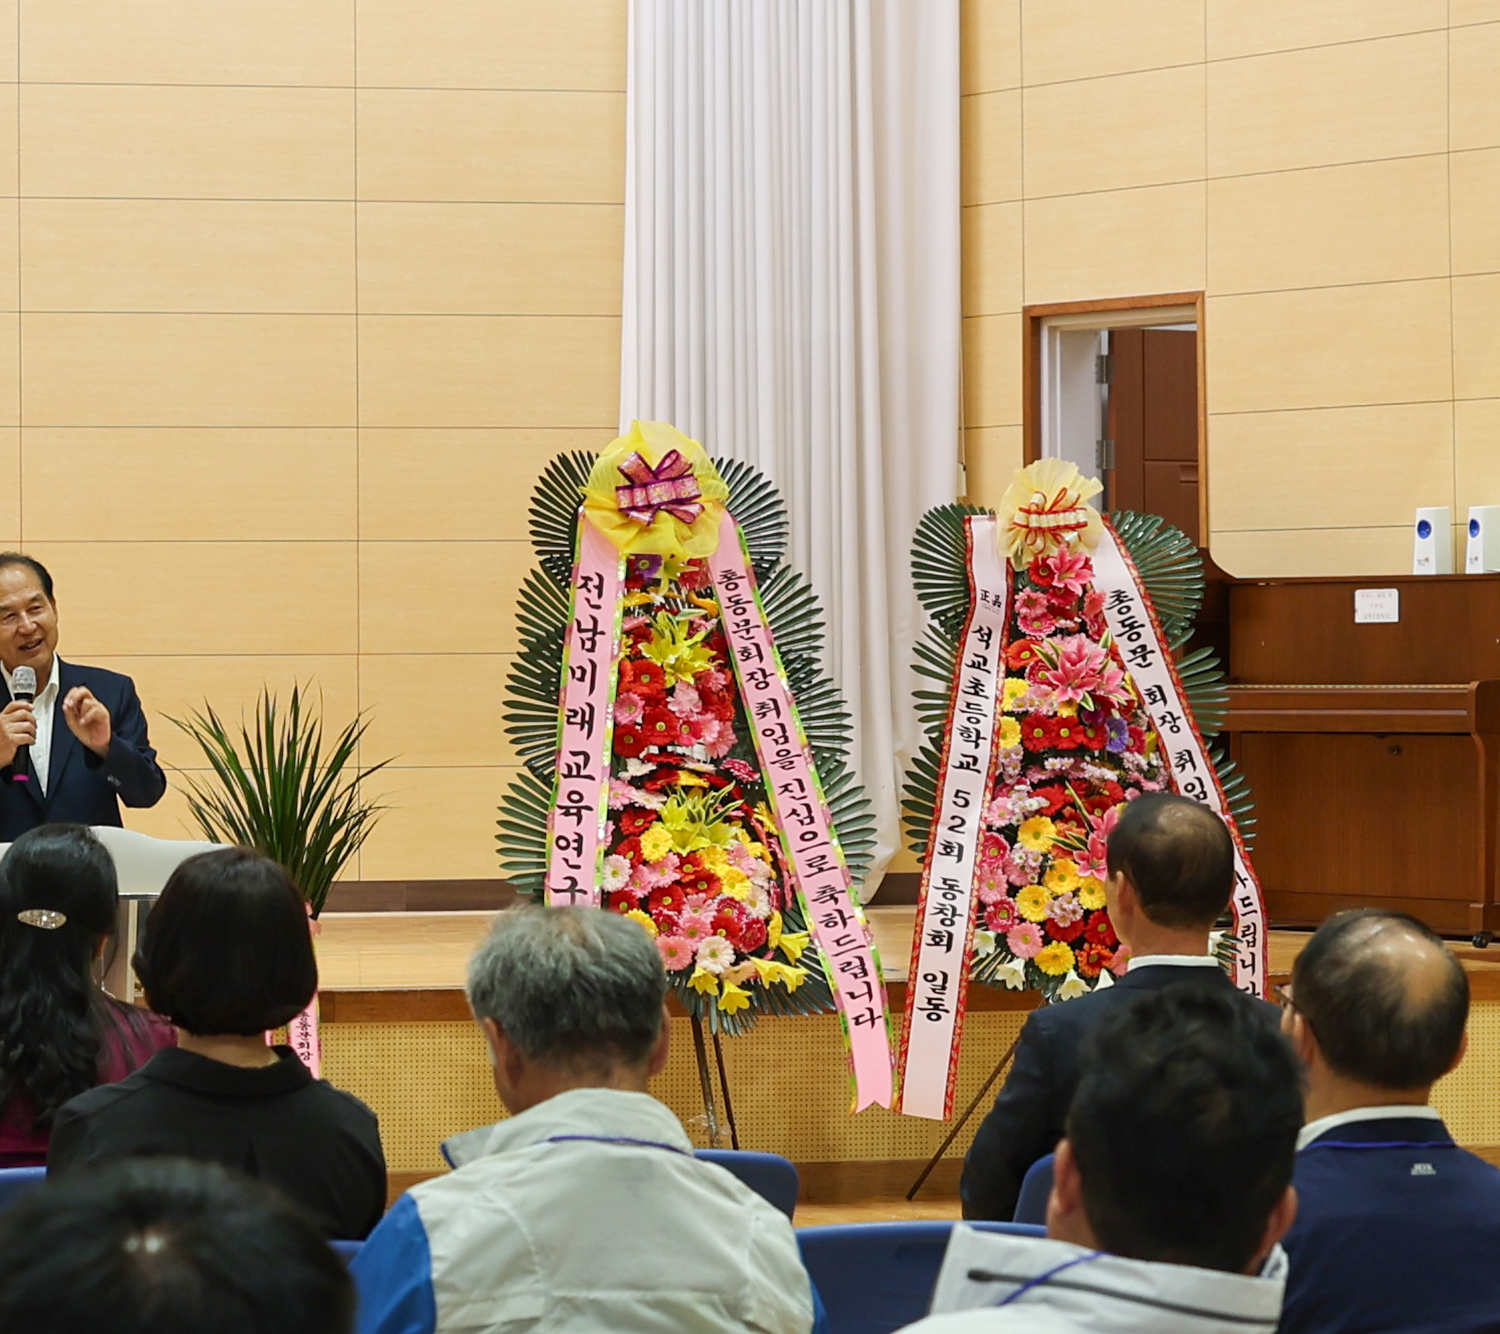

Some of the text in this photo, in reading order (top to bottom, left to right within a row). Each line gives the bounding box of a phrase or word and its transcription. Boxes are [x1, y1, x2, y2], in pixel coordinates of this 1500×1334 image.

[951, 624, 993, 774] 석교초등학교
[716, 569, 883, 1030] 총동문회장 취임을 진심으로 축하드립니다
[1174, 749, 1209, 801] 취임
[925, 877, 965, 954] 동창회
[916, 970, 950, 1022] 일동
